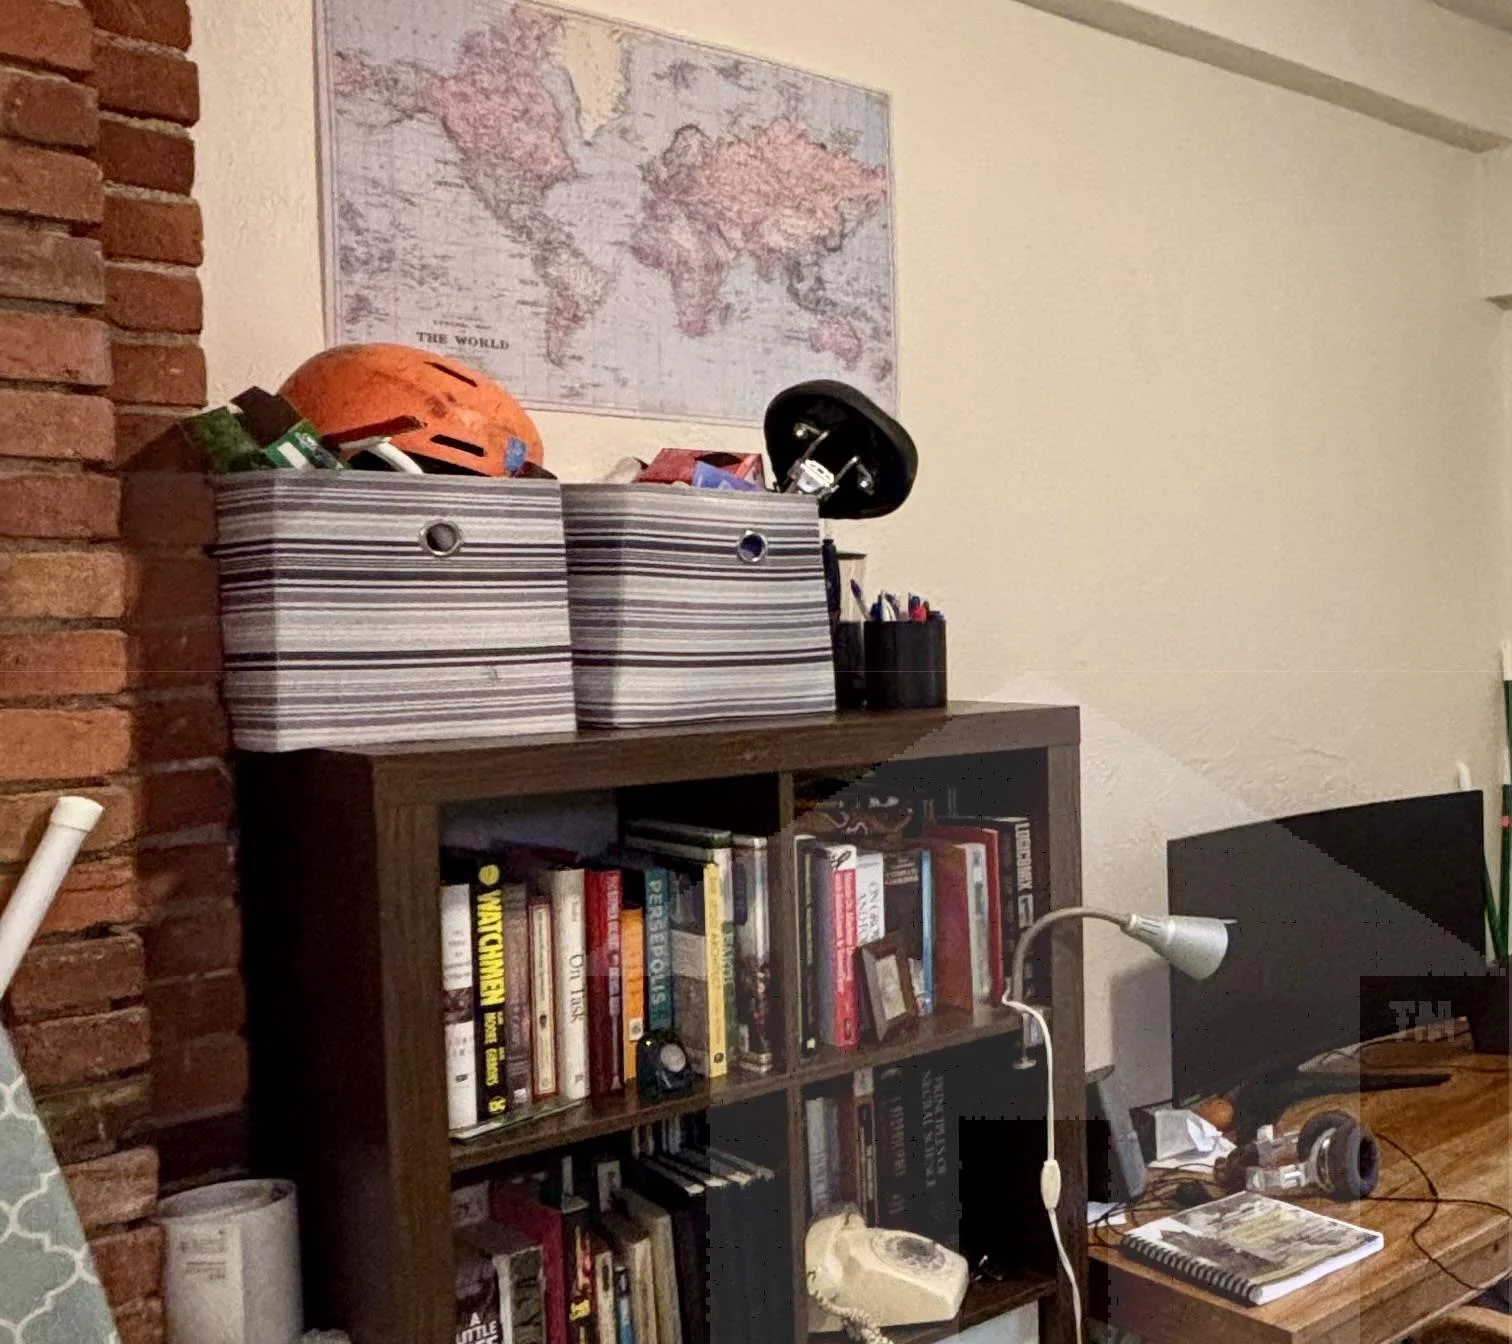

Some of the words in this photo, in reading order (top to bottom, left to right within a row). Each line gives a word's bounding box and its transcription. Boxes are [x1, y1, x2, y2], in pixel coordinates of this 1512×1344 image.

[415, 331, 449, 346] THE
[454, 335, 510, 350] WORLD
[476, 889, 506, 1006] WATCHMEN
[649, 878, 666, 1006] PERSEPOLIS
[569, 953, 584, 980] On
[570, 988, 585, 1024] Task
[469, 1311, 481, 1327] A
